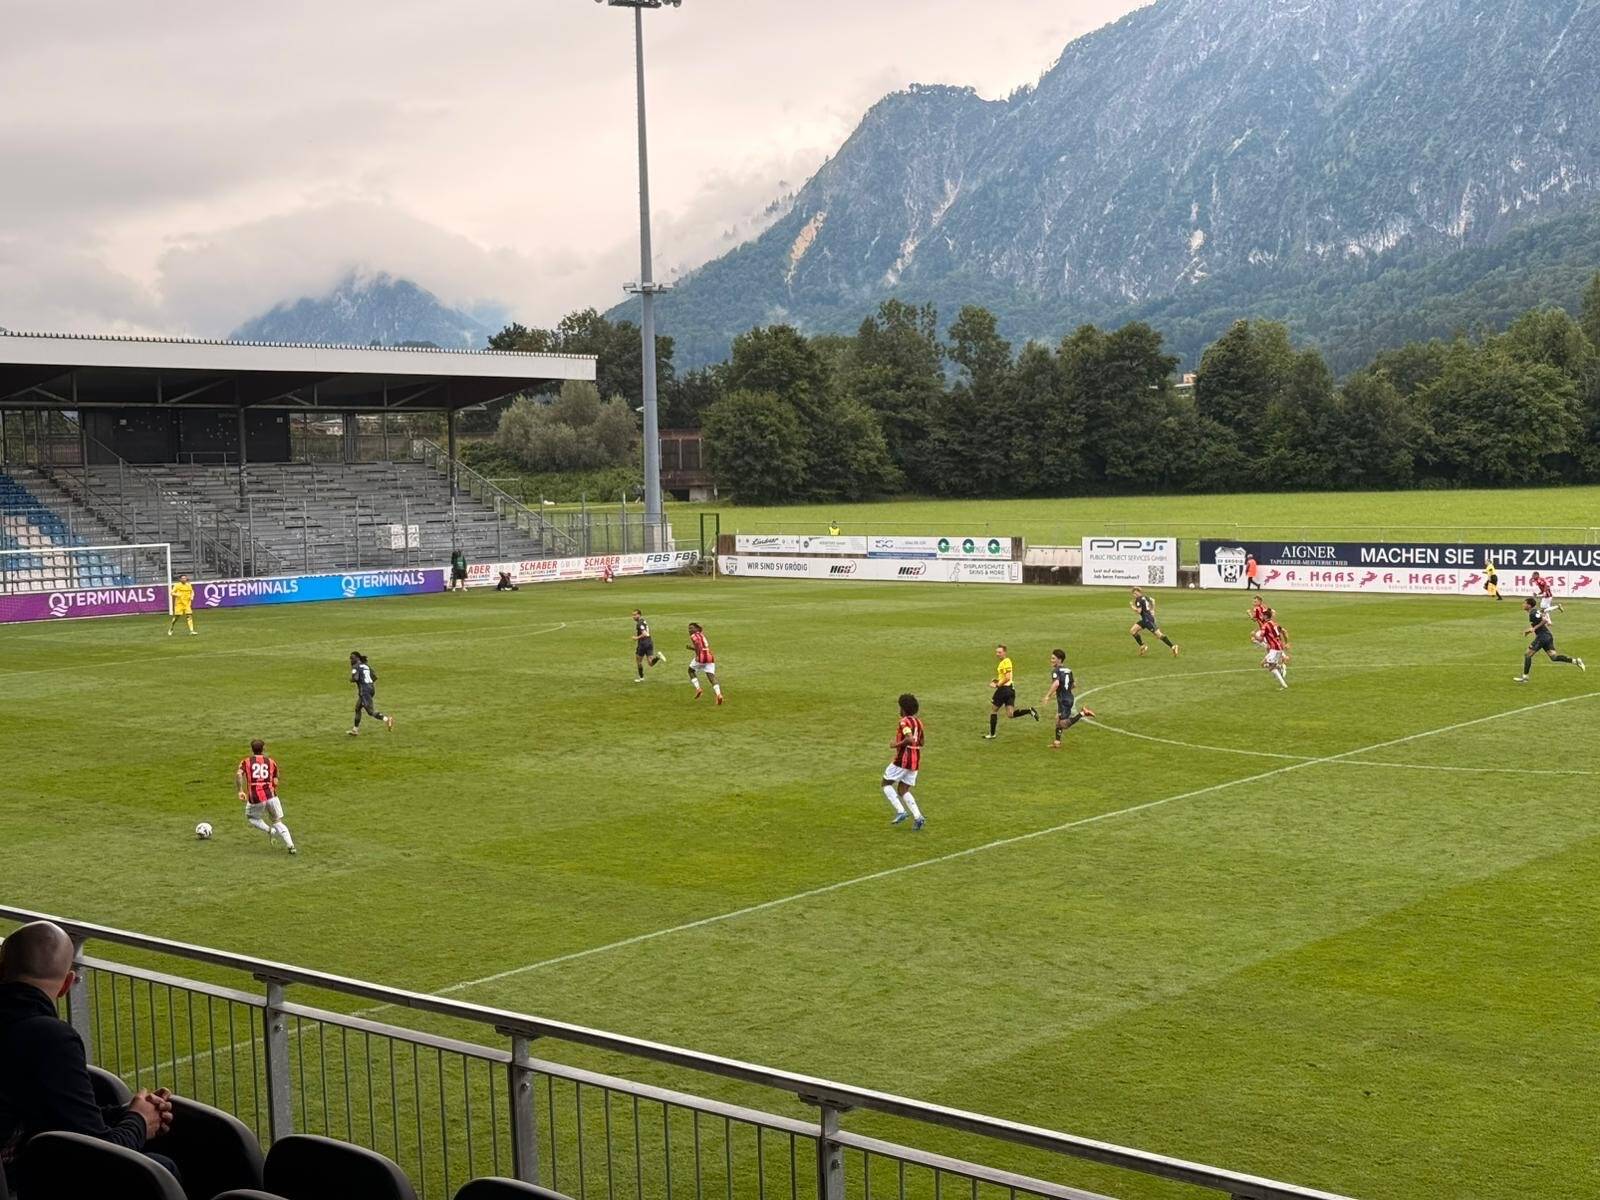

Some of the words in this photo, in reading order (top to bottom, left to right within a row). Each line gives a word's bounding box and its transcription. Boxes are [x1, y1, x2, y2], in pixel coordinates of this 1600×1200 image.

[646, 553, 670, 562] FBS
[675, 551, 697, 561] FBS
[1281, 546, 1336, 558] AIGNER
[1361, 547, 1439, 563] MACHEN
[1444, 549, 1474, 565] SIE
[1485, 549, 1517, 565] IHR
[468, 565, 491, 574] ABER
[520, 560, 557, 571] SCHABER
[585, 556, 620, 567] SCHABER
[747, 561, 758, 570] WIR
[760, 562, 774, 570] SIND
[775, 562, 784, 571] SV
[341, 572, 425, 597] QTERMINALS
[1286, 571, 1302, 581] A.
[1310, 571, 1355, 582] HAAS
[1383, 573, 1400, 583] A.
[1409, 573, 1457, 584] HAAS
[204, 579, 298, 607] QTERMINALS
[48, 587, 155, 617] QTERMINALS
[252, 763, 269, 779] 26
